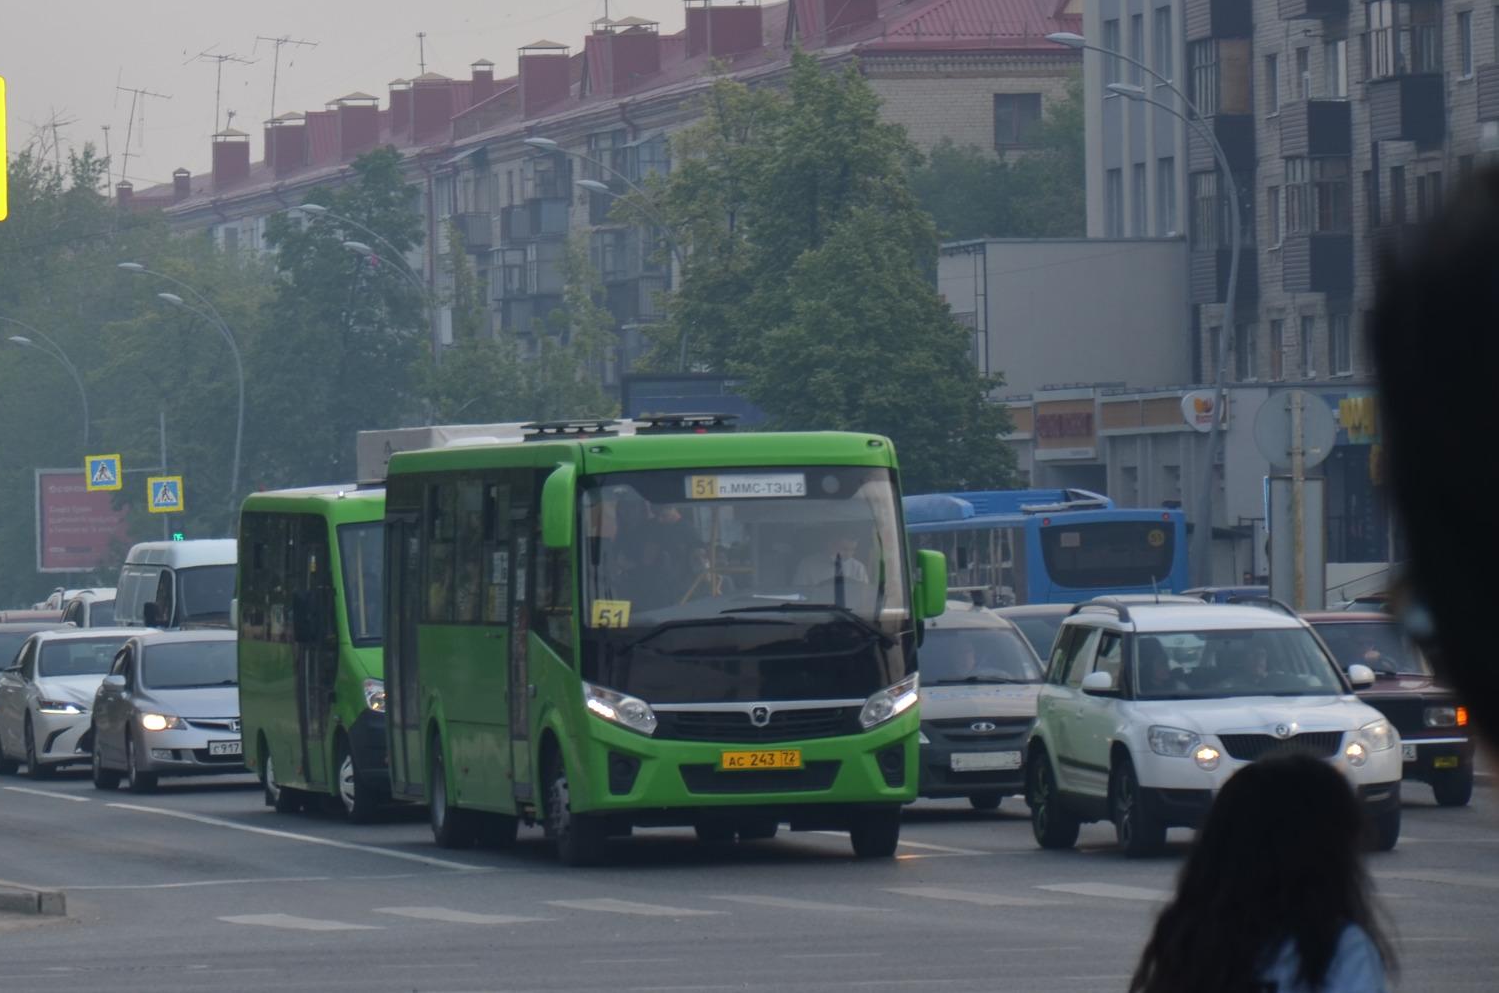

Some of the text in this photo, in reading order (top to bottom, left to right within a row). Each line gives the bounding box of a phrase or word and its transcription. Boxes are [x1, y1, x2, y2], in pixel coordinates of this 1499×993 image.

[696, 479, 715, 495] 51
[796, 482, 805, 493] 2
[598, 609, 623, 628] 51
[750, 753, 775, 766] 243
[782, 752, 796, 763] 72
